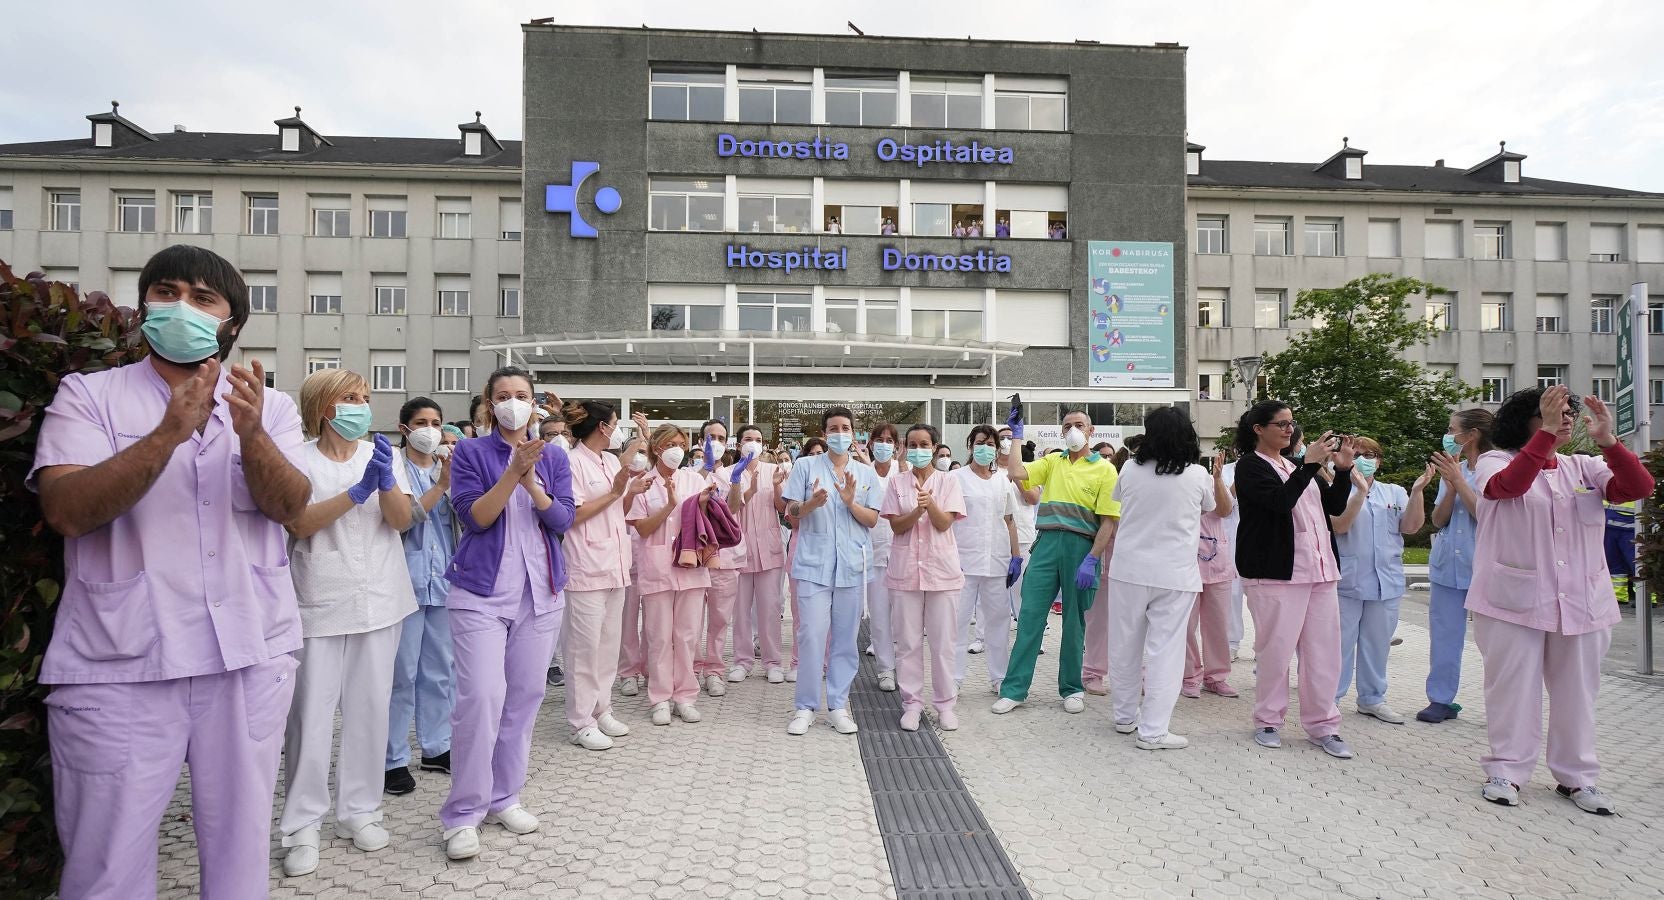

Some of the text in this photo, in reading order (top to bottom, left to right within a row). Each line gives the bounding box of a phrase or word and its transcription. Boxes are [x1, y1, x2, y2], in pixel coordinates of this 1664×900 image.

[718, 133, 1014, 168] Donostia Ospitalea
[727, 245, 1012, 275] Hospital Donostia
[1109, 267, 1158, 275] BABESTEKO?
